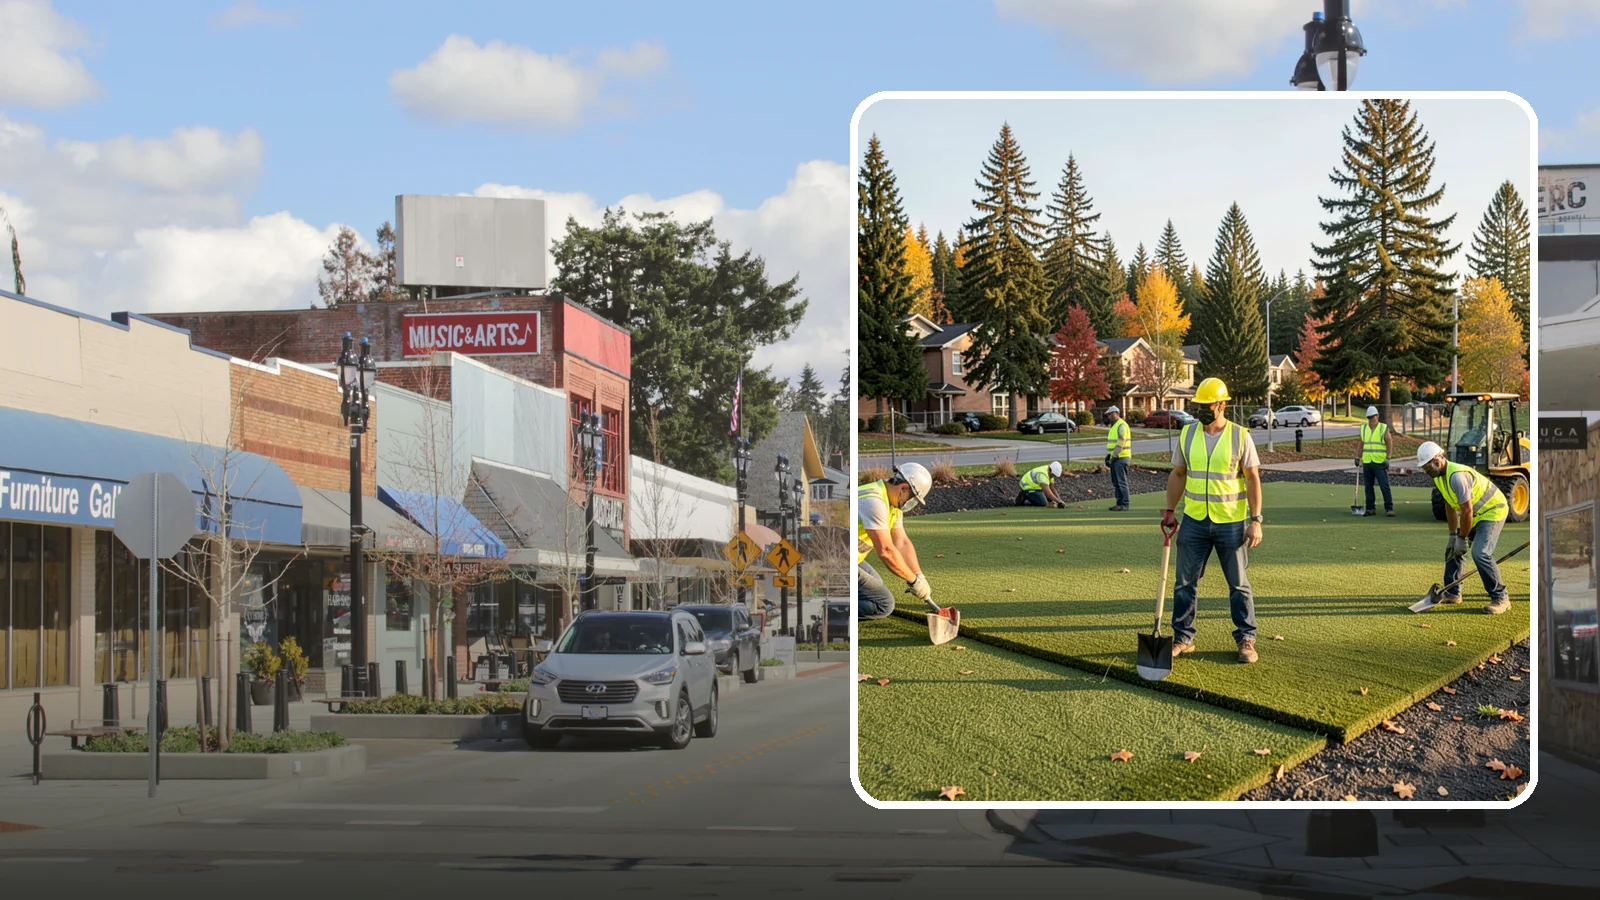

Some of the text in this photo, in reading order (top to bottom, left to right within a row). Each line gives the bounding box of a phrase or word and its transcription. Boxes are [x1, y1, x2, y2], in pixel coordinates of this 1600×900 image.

[0, 472, 122, 519] Furniture Gal
[453, 563, 480, 574] SUSHI
